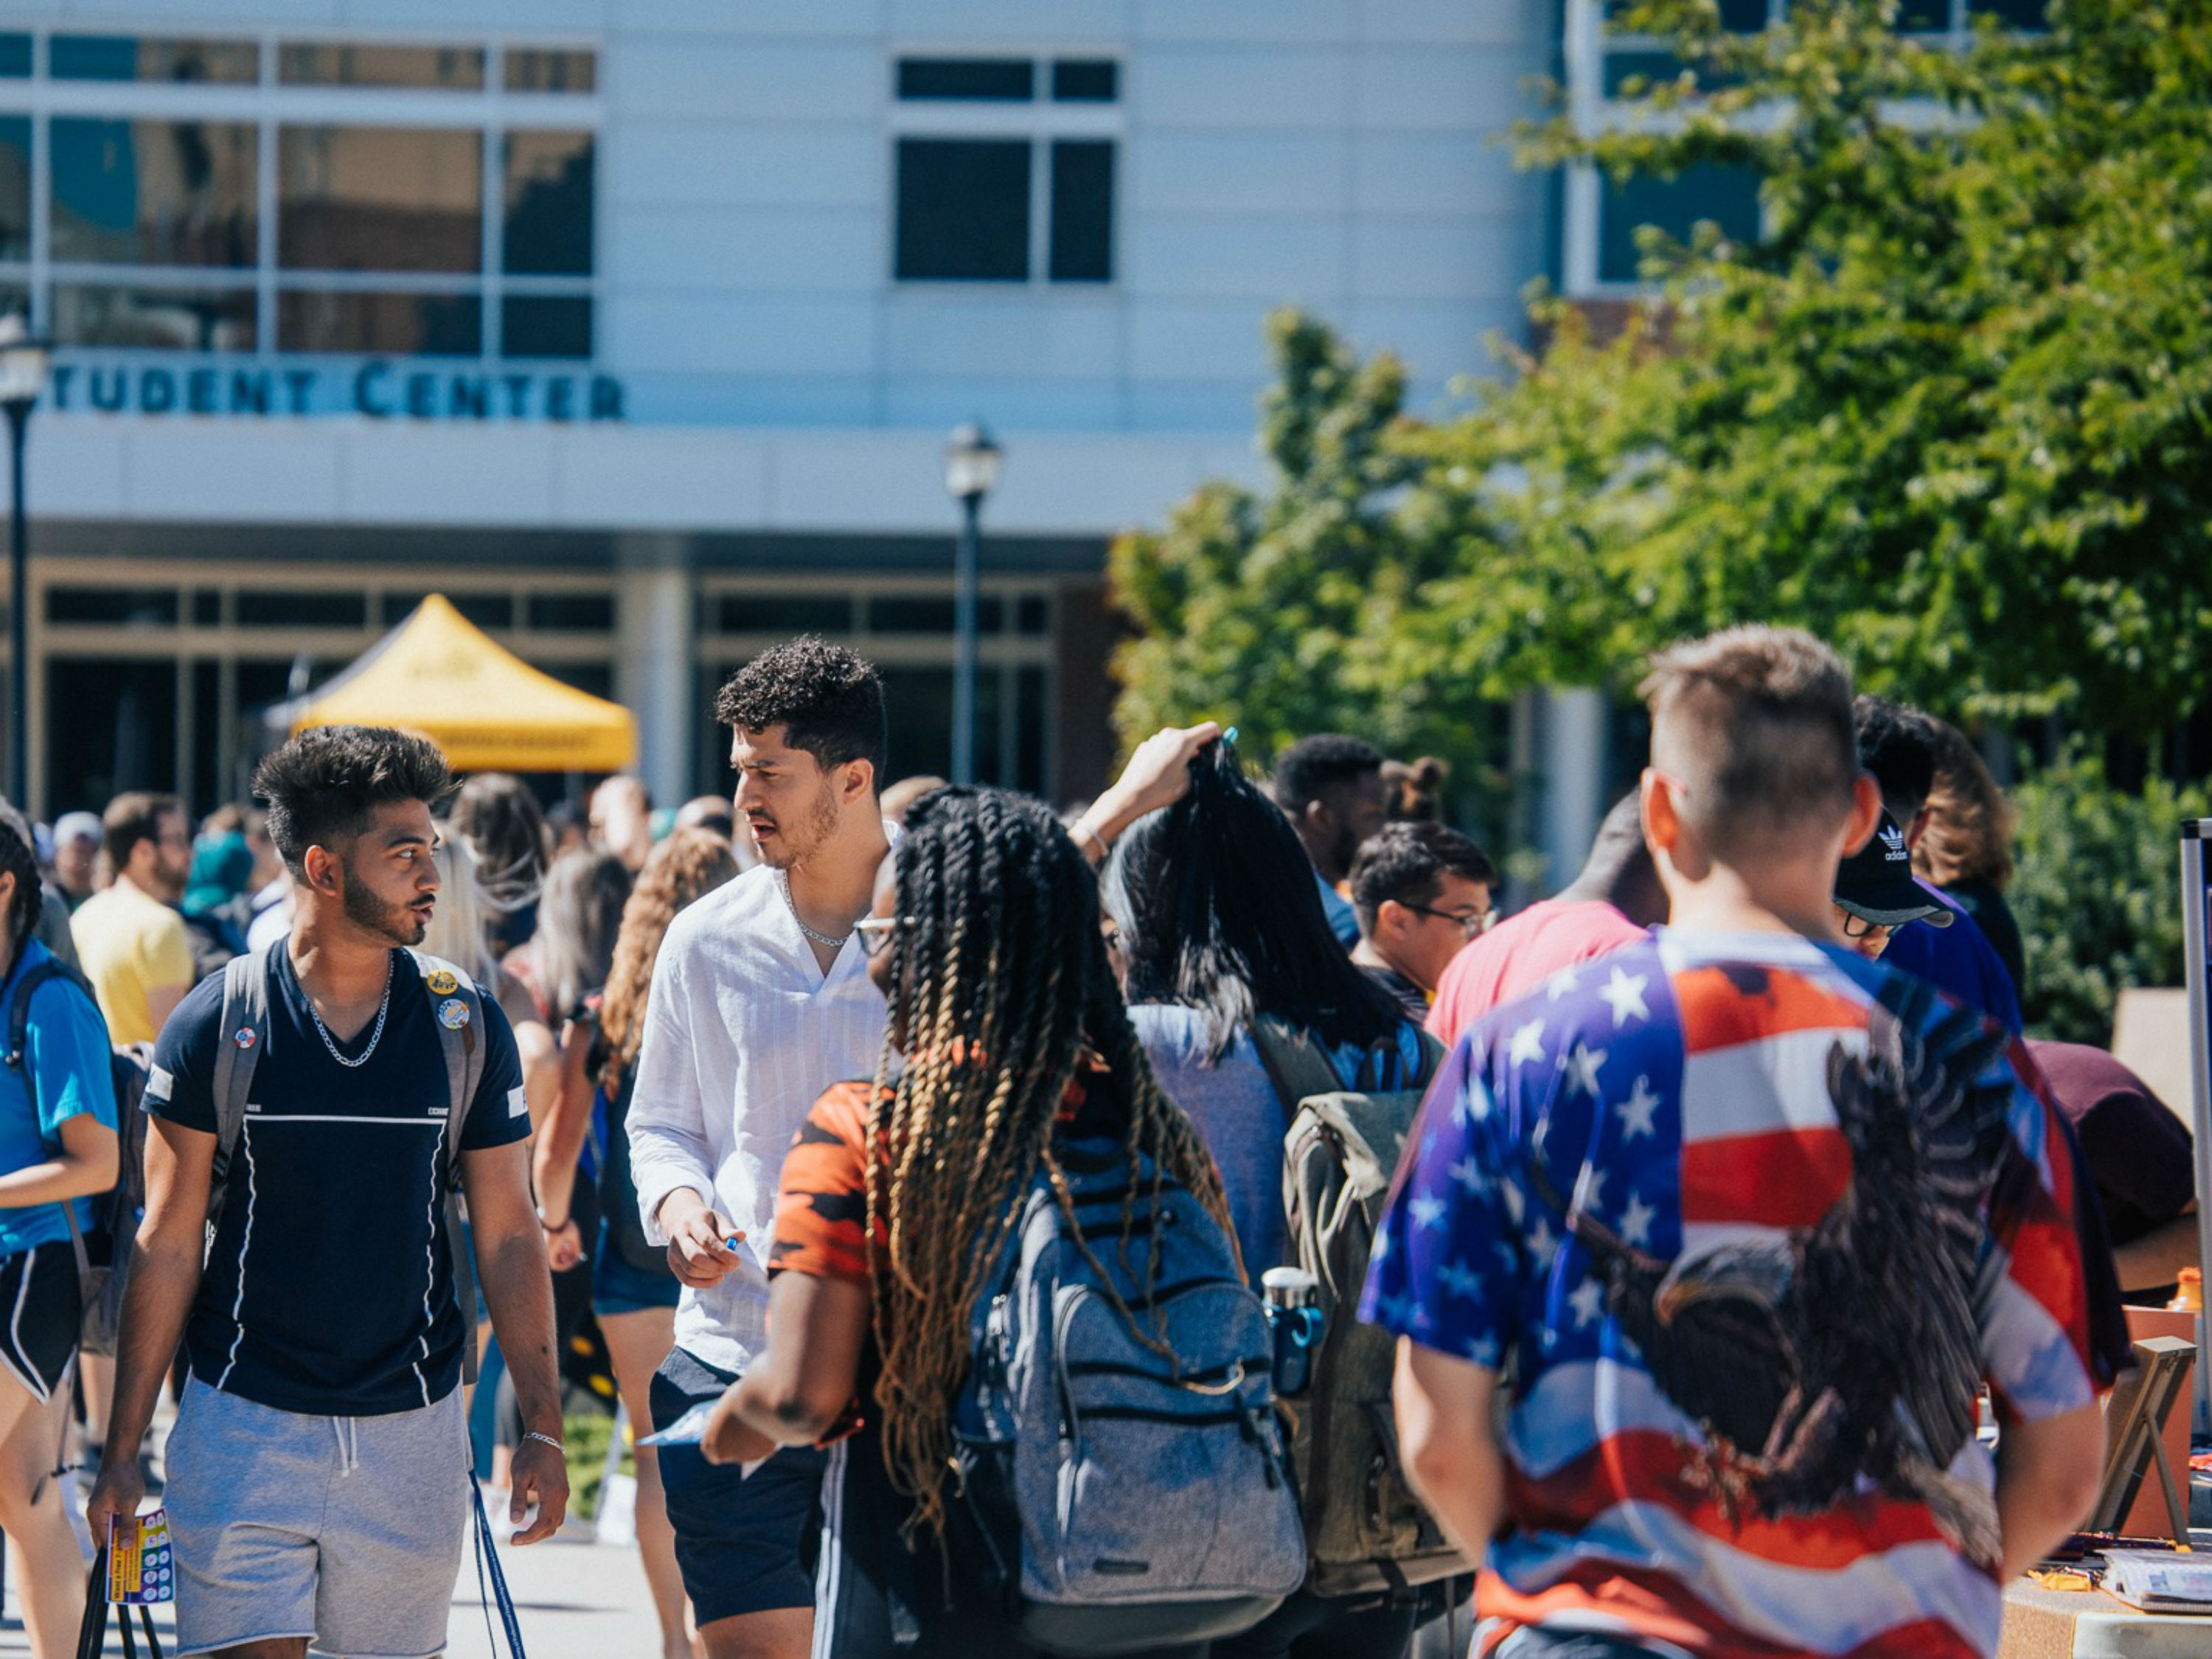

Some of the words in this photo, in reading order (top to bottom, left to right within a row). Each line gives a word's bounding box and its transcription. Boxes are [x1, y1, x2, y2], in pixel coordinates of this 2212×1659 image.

[52, 366, 319, 414] TUDENT
[353, 359, 626, 421] CENTER
[1885, 850, 1907, 860] adidas
[113, 1581, 121, 1599] Want
